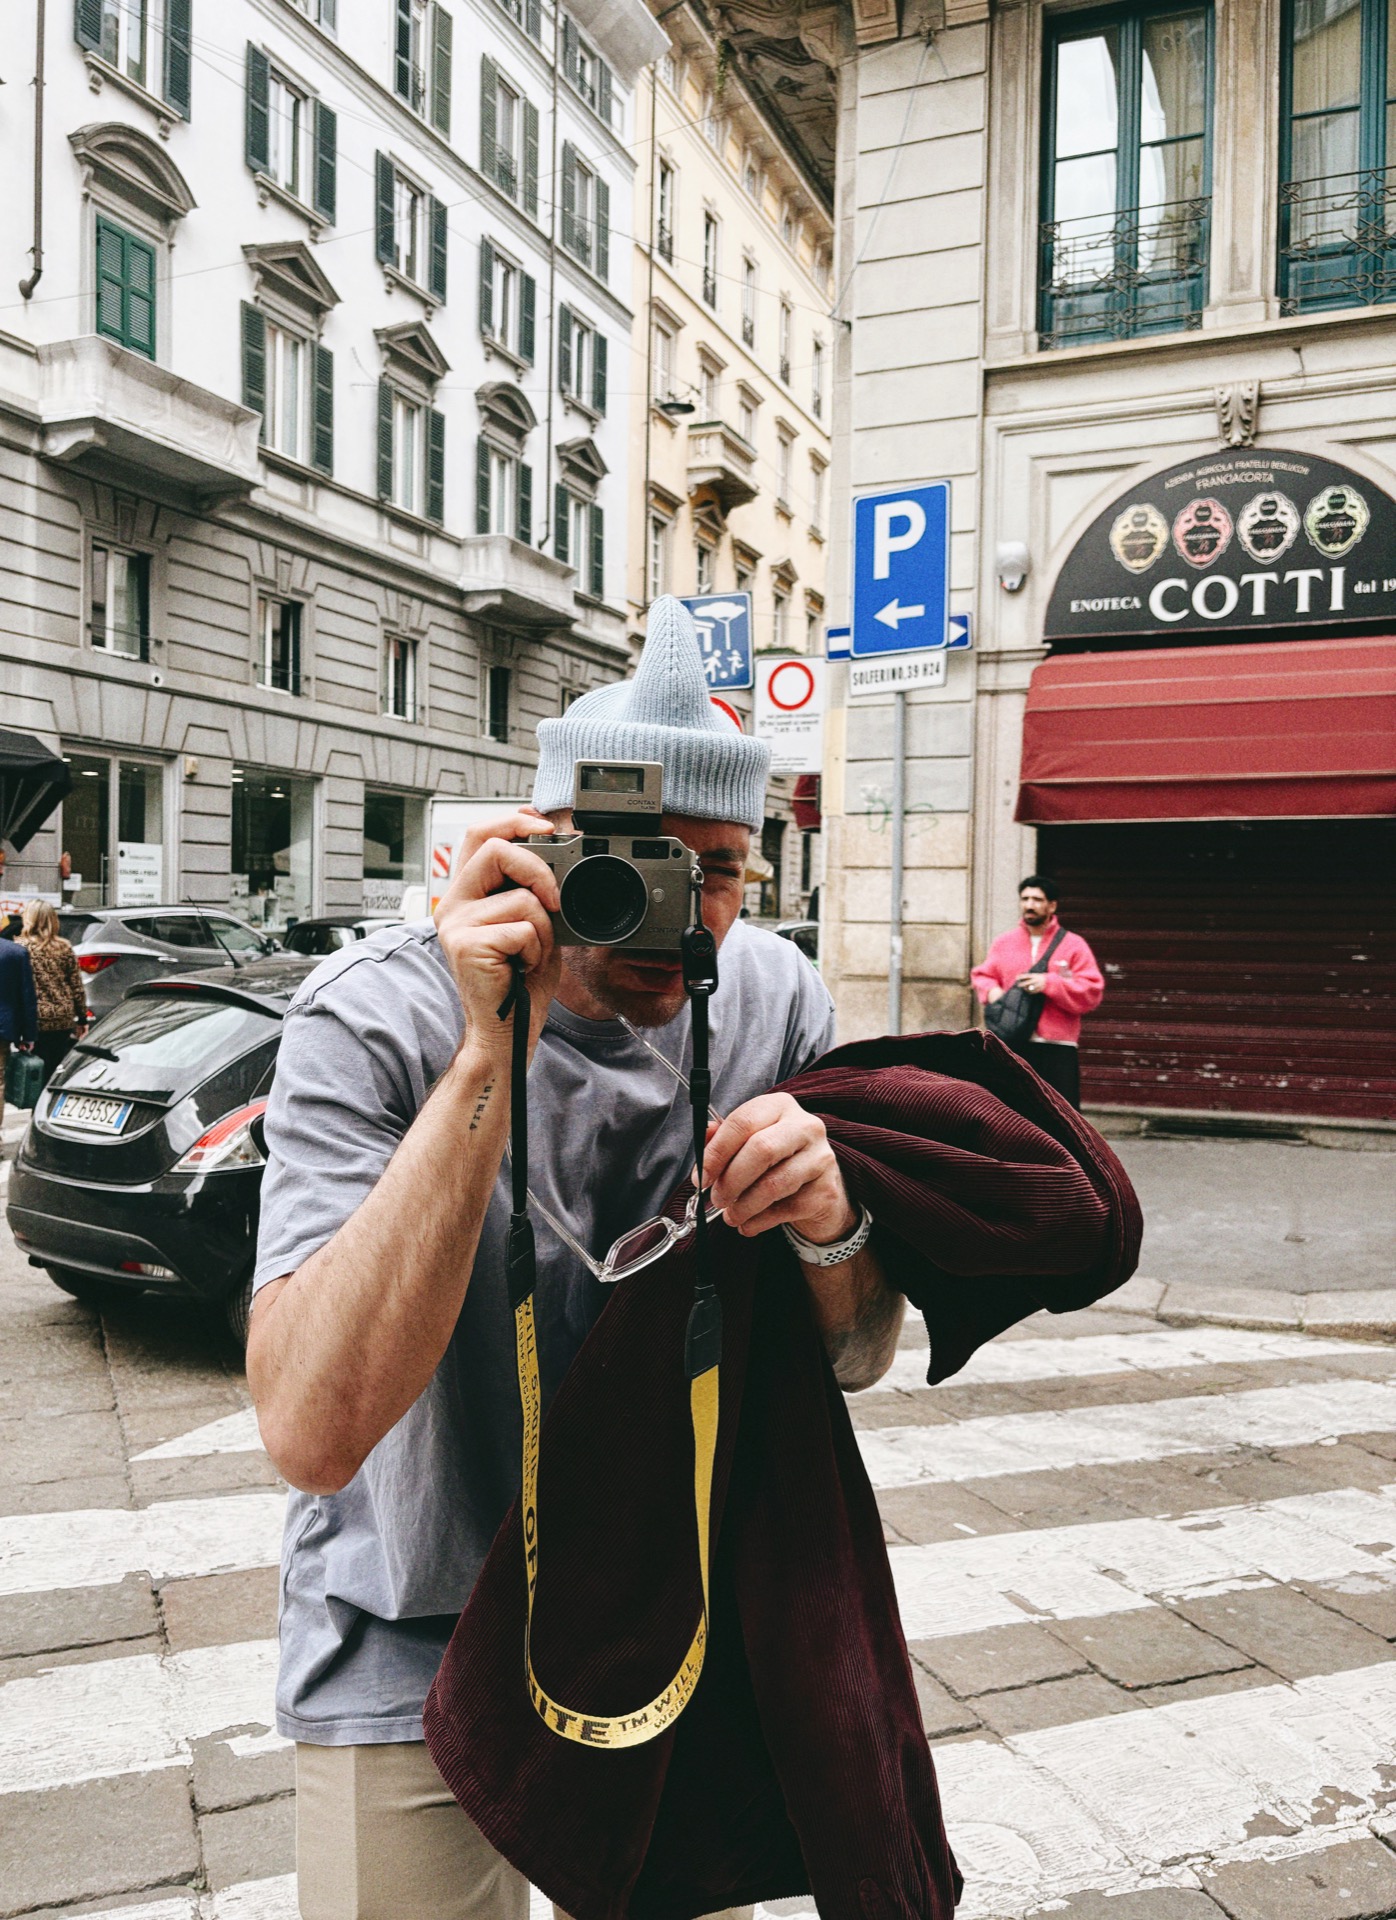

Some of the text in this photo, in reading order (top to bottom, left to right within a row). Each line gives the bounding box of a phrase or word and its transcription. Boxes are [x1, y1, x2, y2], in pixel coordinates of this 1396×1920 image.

[1195, 462, 1234, 477] AGRICOLA
[1234, 459, 1270, 470] FRATELLI
[1195, 472, 1275, 491] FRANCIACORTA
[873, 499, 927, 581] P
[1069, 596, 1142, 614] ENOTECA
[1148, 566, 1347, 623] COTTI
[1353, 579, 1377, 595] dal
[647, 926, 680, 934] CONTAX
[654, 1662, 694, 1714] WILL
